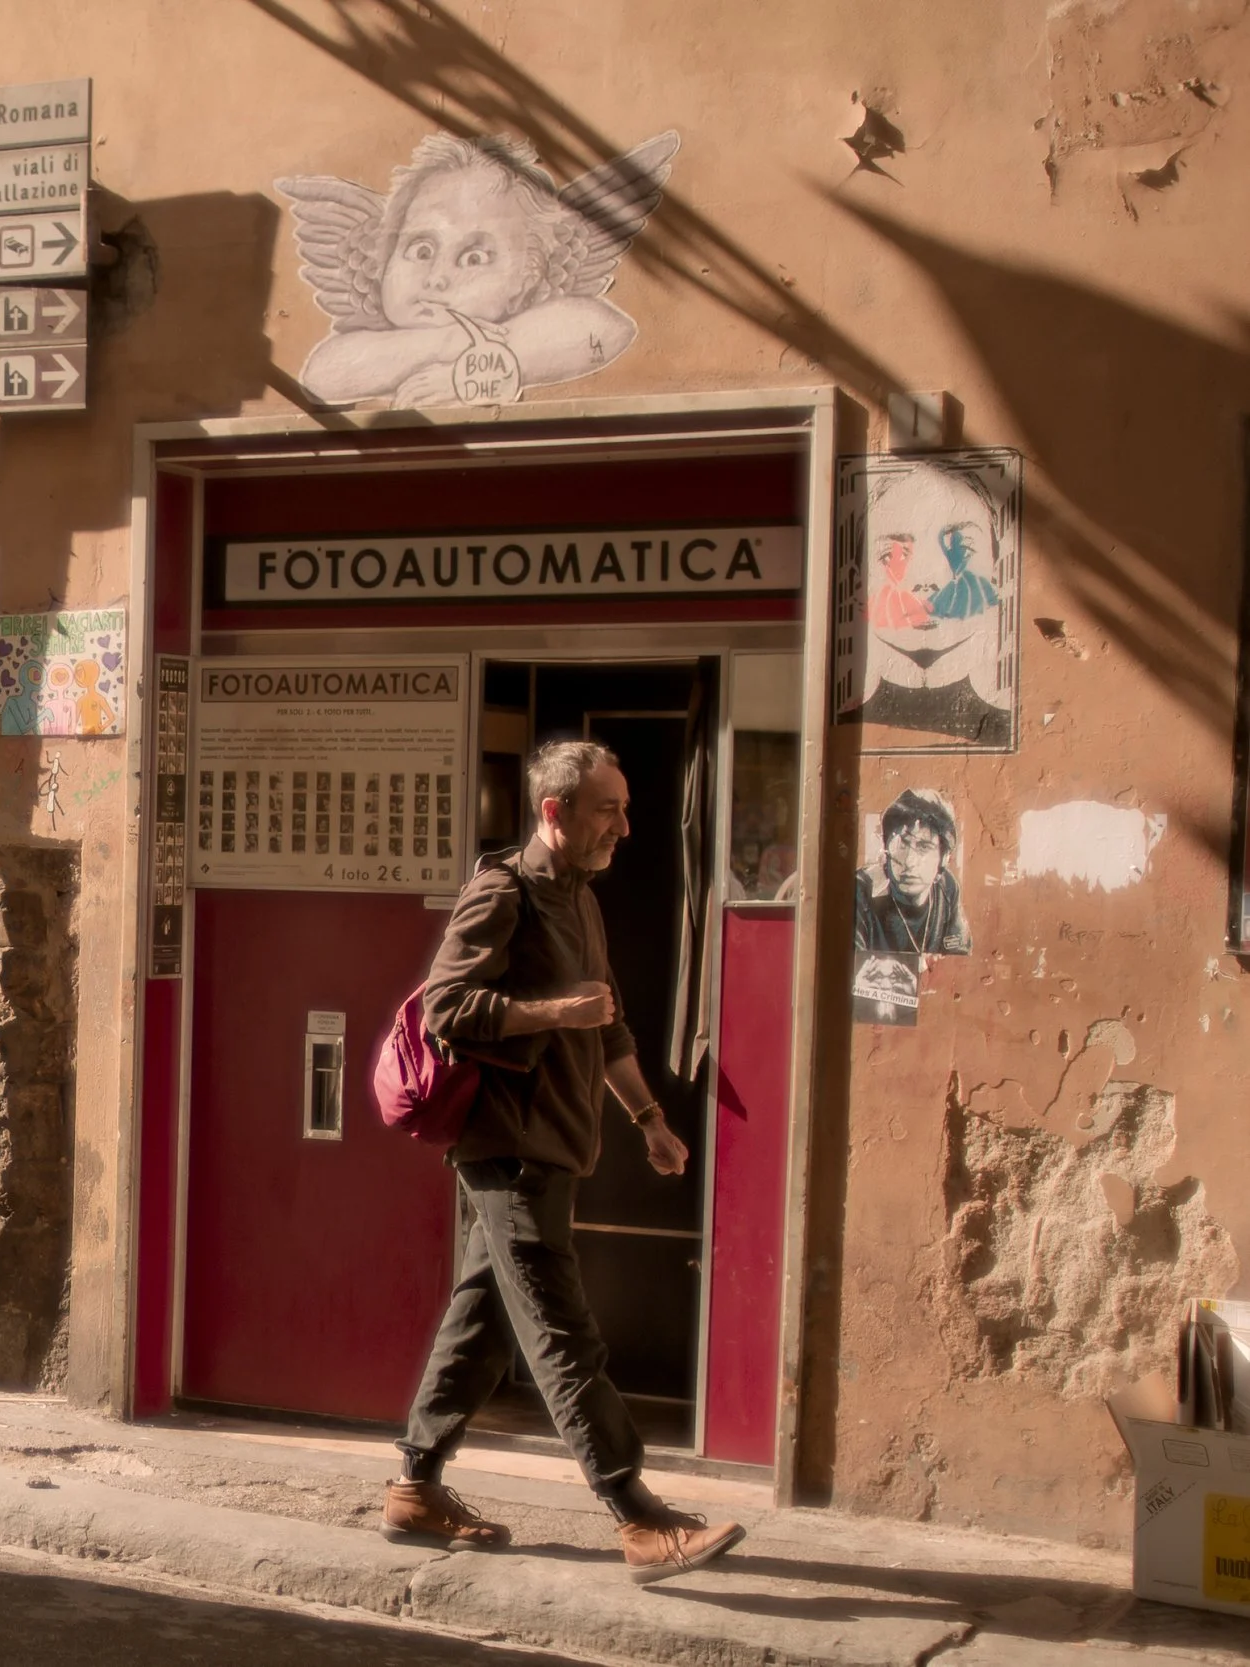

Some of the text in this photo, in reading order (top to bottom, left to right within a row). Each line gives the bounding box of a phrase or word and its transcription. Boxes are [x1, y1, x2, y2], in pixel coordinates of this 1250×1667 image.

[12, 152, 79, 177] viali di
[258, 538, 763, 590] FOTOAUTOMATICA
[208, 672, 452, 696] FOTOAUTOMATICA
[324, 864, 334, 879] 4
[341, 864, 370, 881] foto
[880, 993, 917, 1005] Criminal
[1145, 1486, 1175, 1514] ITALY
